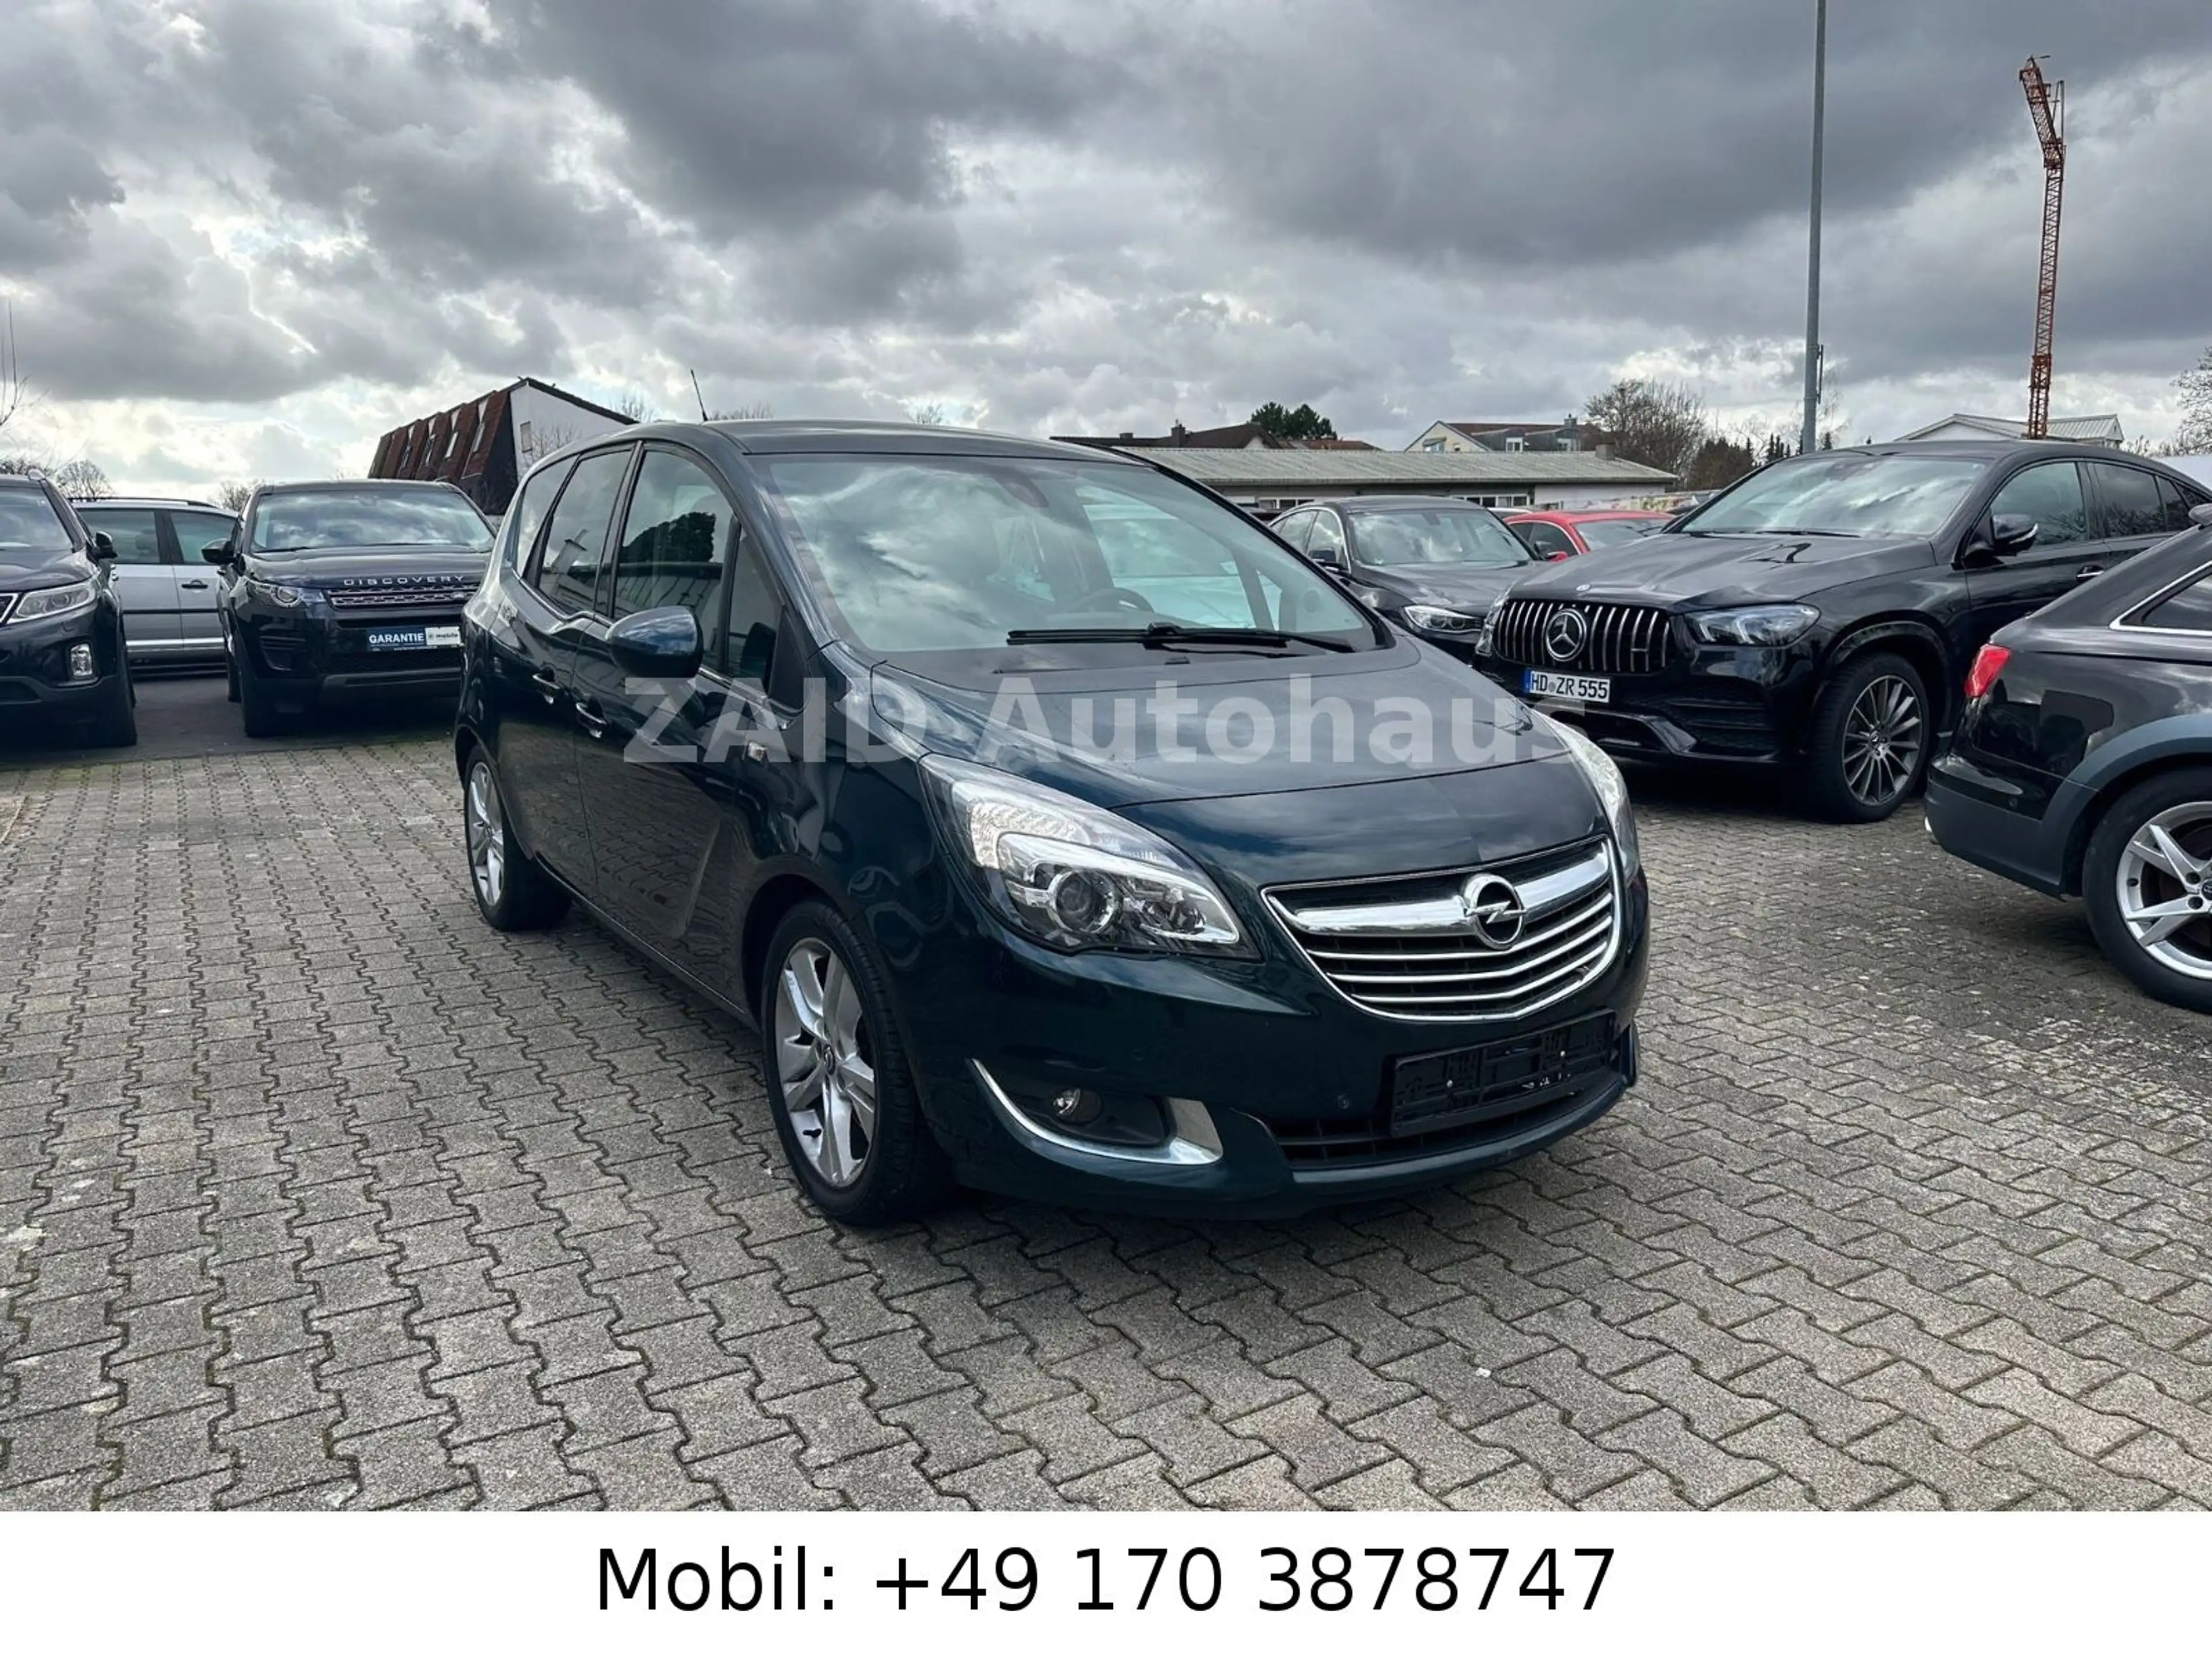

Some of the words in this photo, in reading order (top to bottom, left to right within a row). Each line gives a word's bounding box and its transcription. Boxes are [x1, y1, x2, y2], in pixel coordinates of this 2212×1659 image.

[343, 575, 464, 586] DISCOVERY
[368, 632, 425, 644] GARANTIE
[1531, 673, 1548, 692] HD
[1556, 677, 1575, 696] ZR
[1578, 679, 1609, 699] 555
